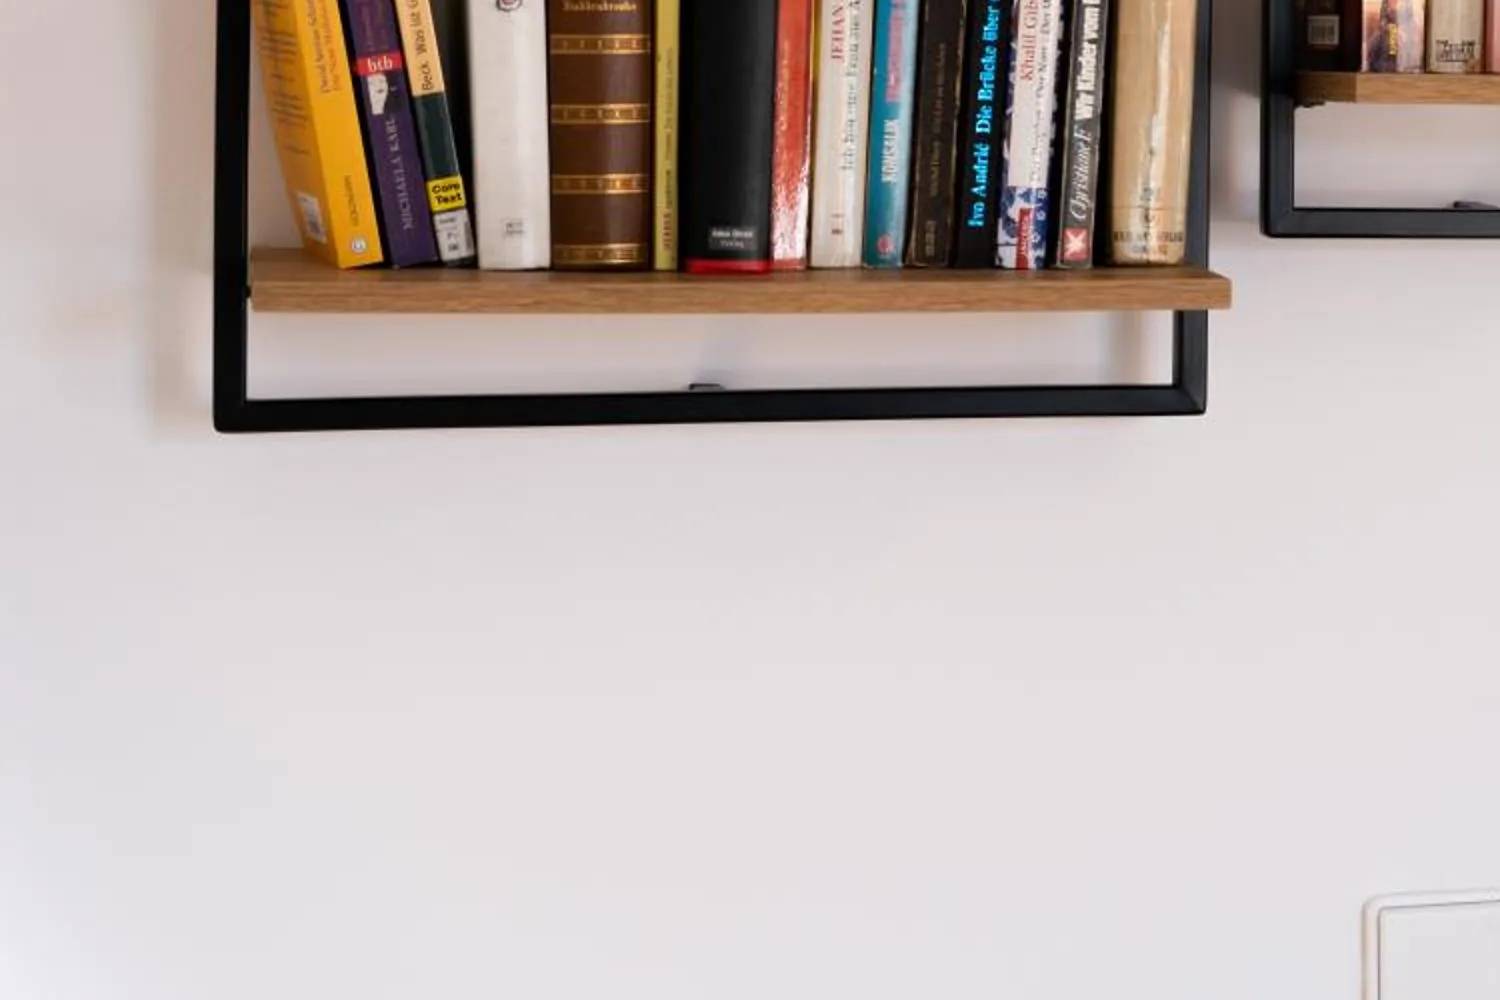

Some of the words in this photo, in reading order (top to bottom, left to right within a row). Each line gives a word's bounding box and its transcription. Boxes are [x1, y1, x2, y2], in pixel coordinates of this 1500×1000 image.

[831, 5, 847, 61] JEHAN
[983, 5, 1000, 43] über
[1083, 6, 1099, 39] vom
[367, 56, 393, 72] btb
[1020, 30, 1037, 81] Khalil
[1077, 41, 1098, 91] Kinder
[978, 45, 998, 102] Brücke
[976, 105, 992, 134] Die
[1075, 92, 1095, 121] Wir
[971, 143, 991, 197] Andrić
[435, 191, 462, 205] Text
[968, 200, 985, 227] Ivo
